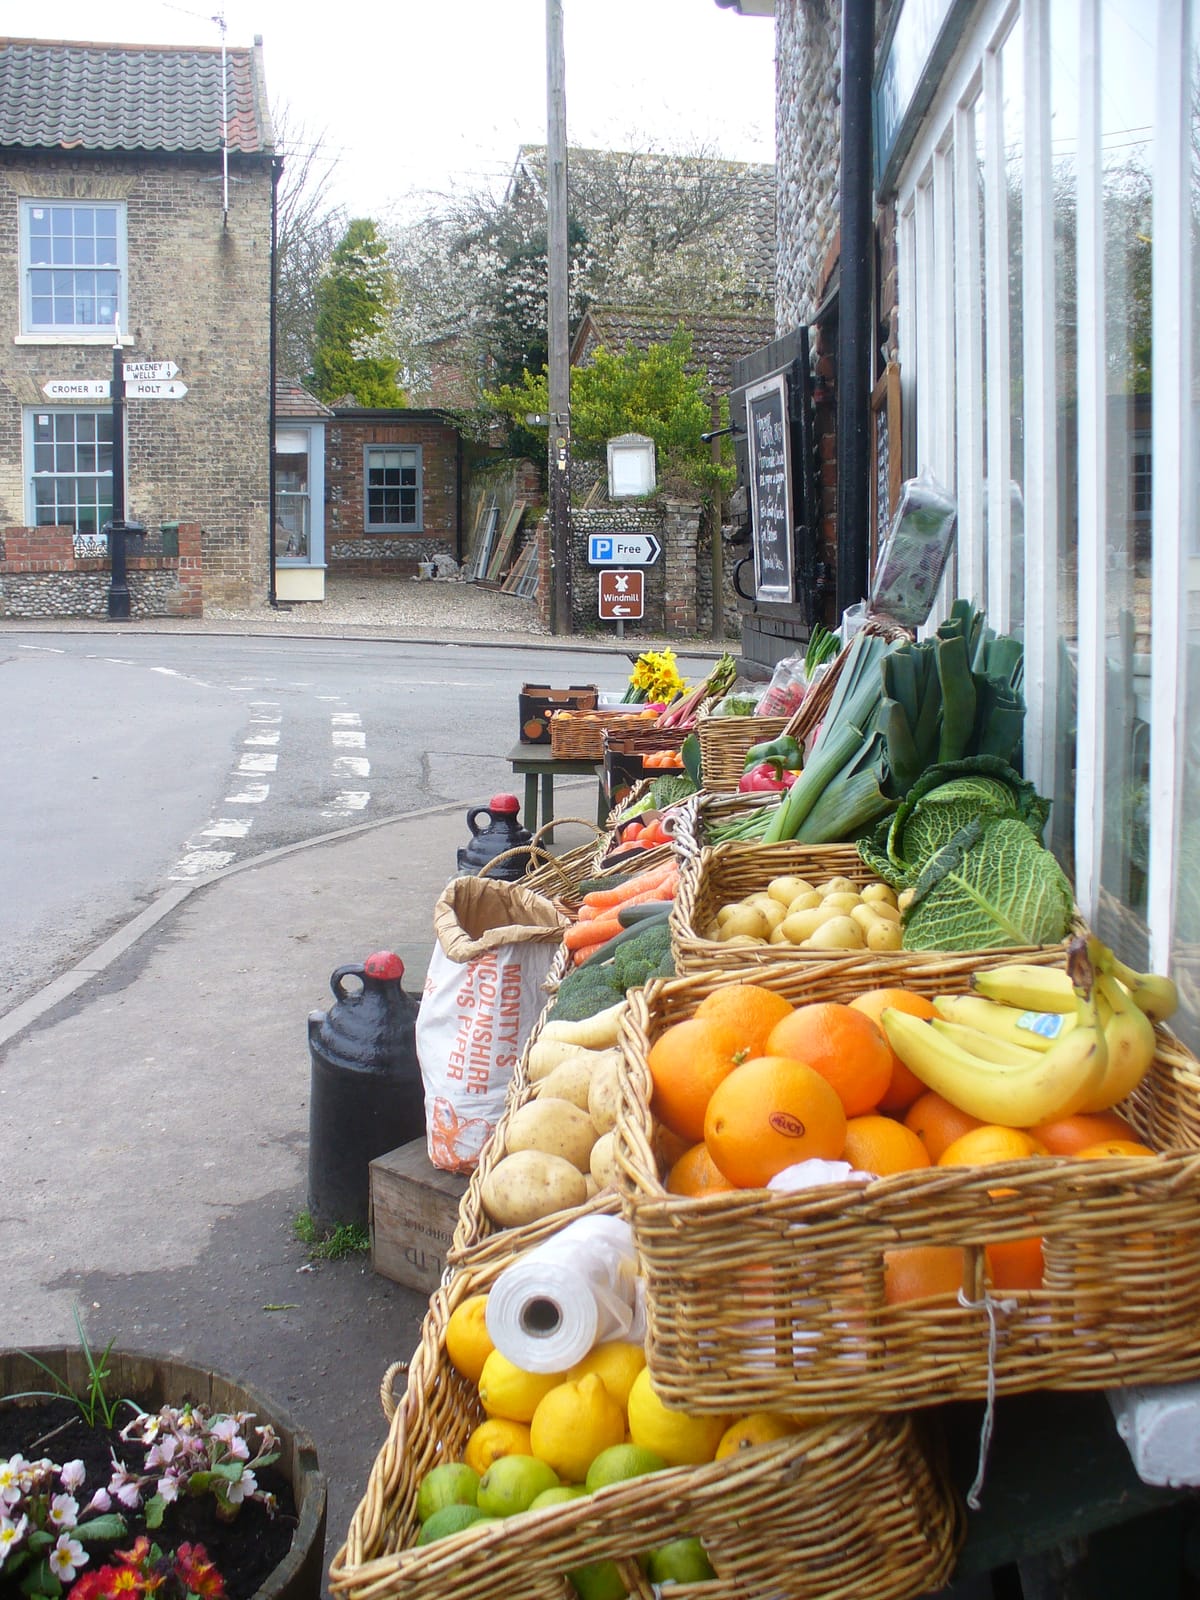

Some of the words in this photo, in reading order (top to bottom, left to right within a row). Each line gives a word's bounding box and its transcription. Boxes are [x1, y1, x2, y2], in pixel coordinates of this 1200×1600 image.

[126, 363, 162, 372] BLAKENEY
[52, 385, 89, 393] CROMER
[95, 385, 104, 393] 12
[138, 385, 161, 393] HOLT
[596, 540, 611, 559] P
[617, 544, 641, 554] Free
[603, 593, 639, 602] Windmill
[466, 947, 498, 1095] NCOLNSHIRE
[495, 963, 521, 1067] MONTY'S
[447, 1014, 473, 1081] PIPER
